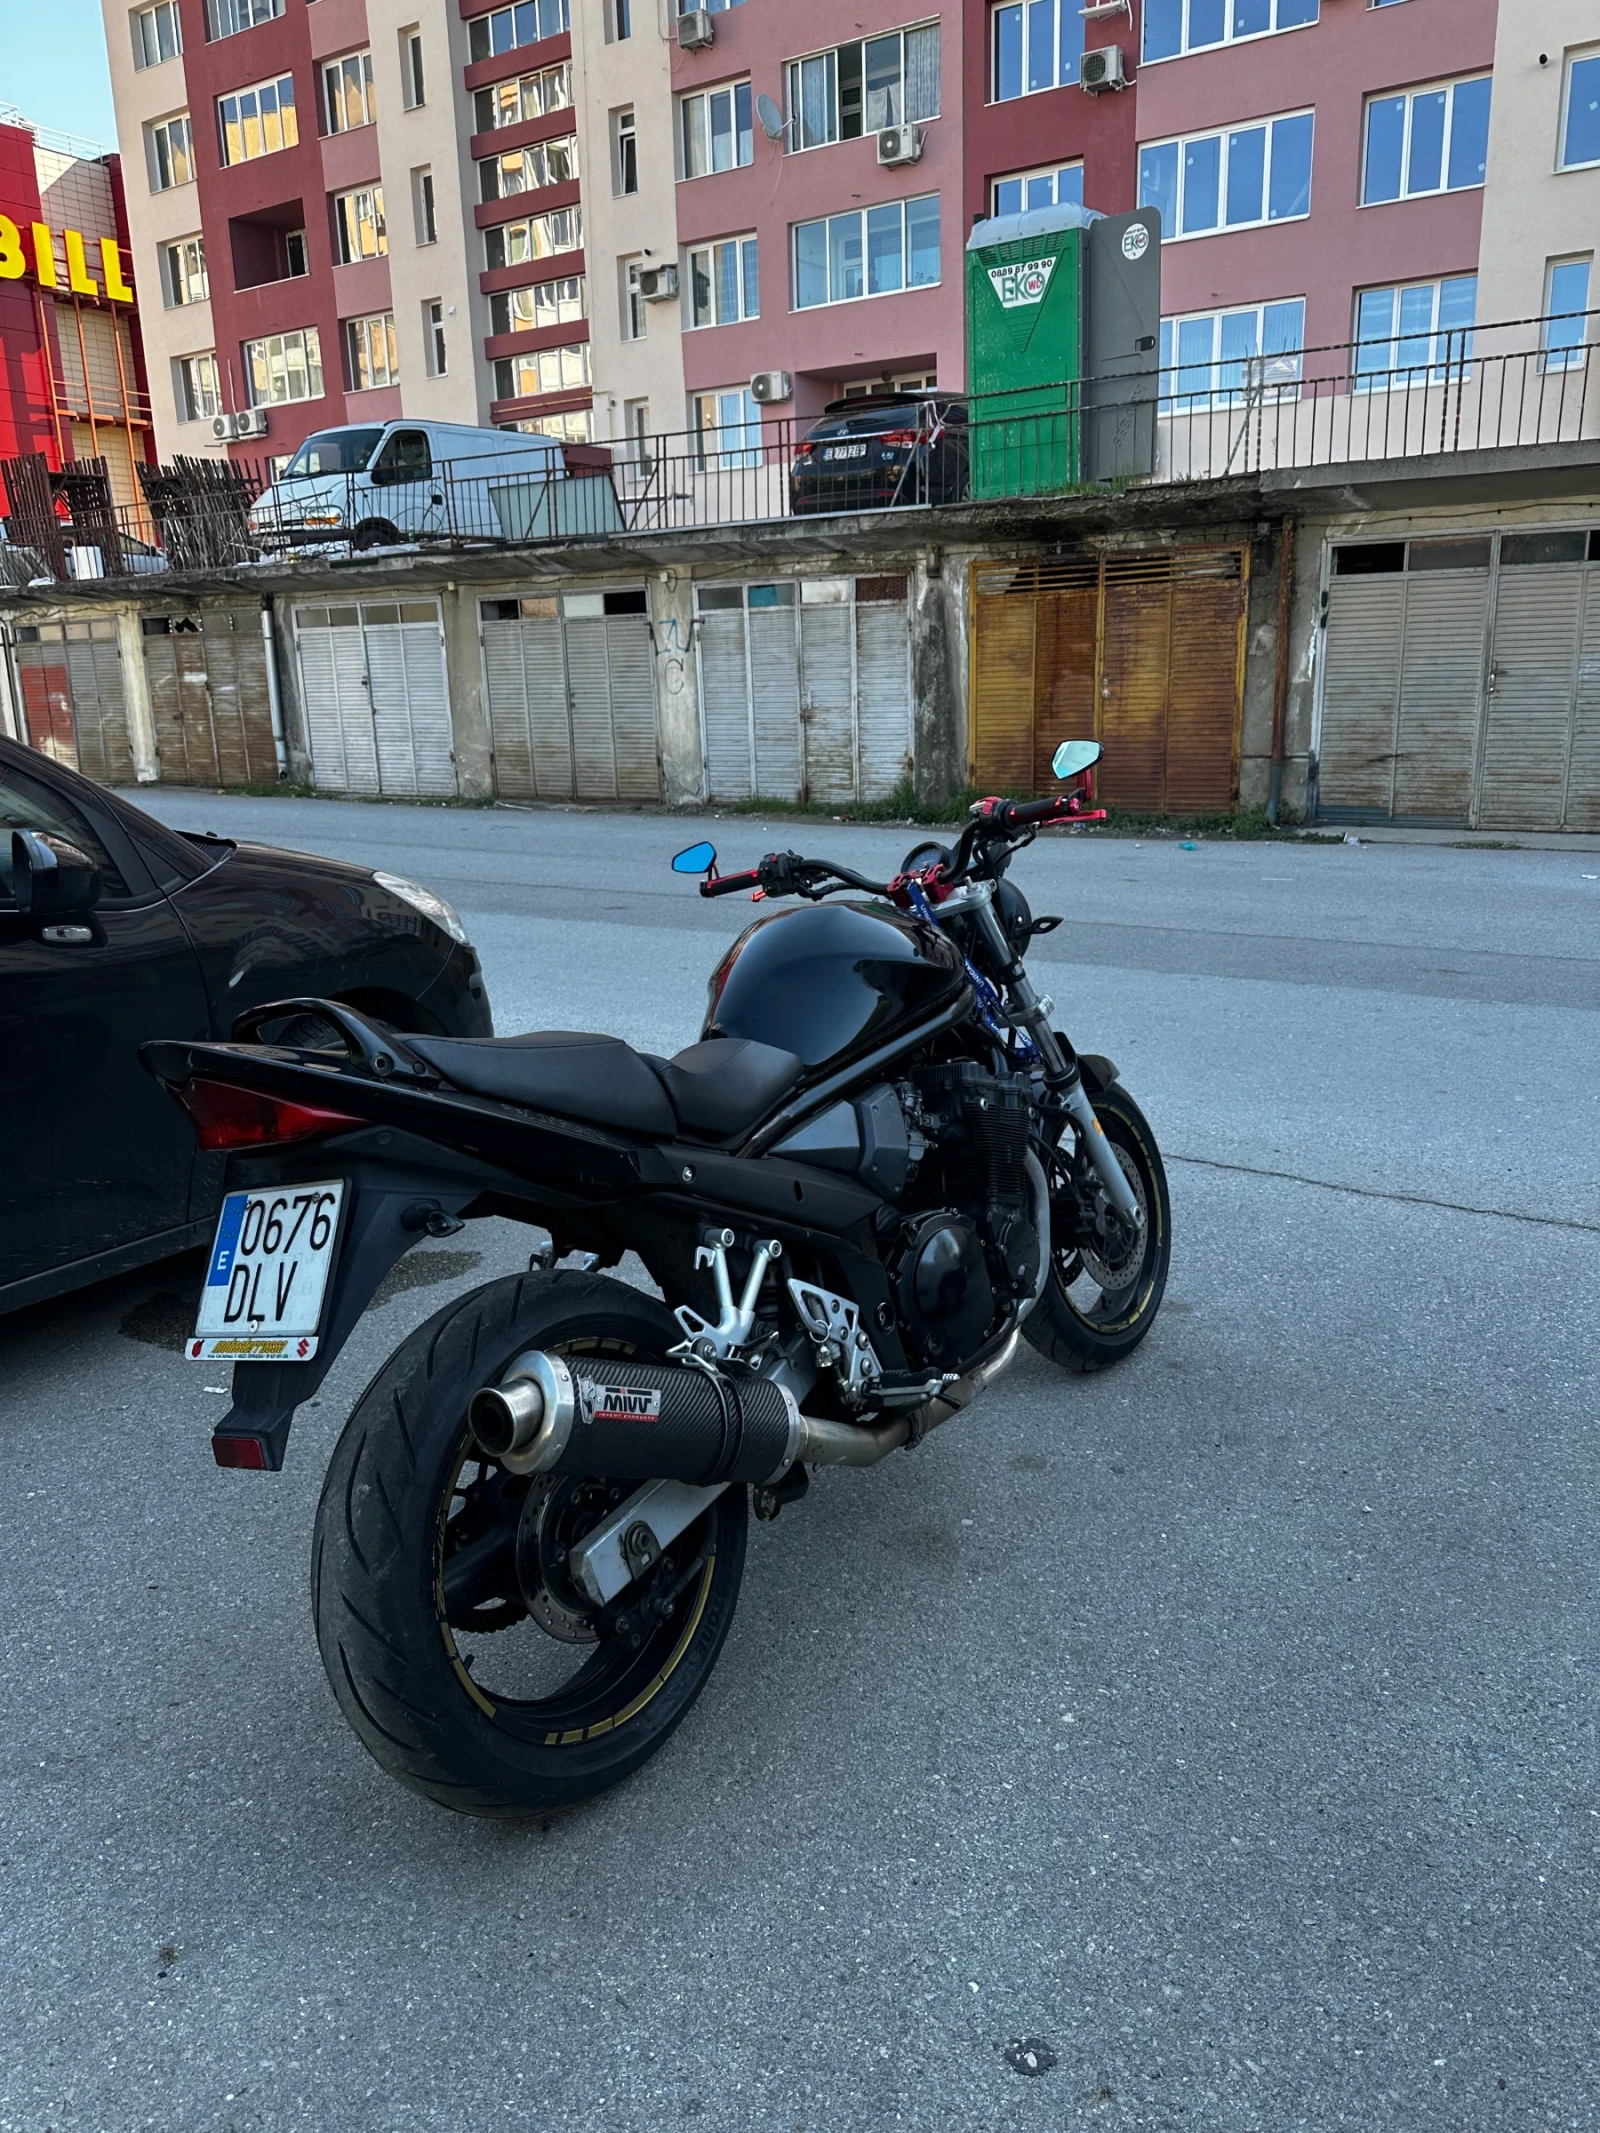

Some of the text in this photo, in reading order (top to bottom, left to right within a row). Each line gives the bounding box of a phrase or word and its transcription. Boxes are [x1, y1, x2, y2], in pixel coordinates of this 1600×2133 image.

[991, 259, 1053, 278] 0889 87 99 90
[1002, 271, 1046, 303] EKO
[240, 1192, 336, 1257] 0676
[217, 1250, 230, 1270] E
[223, 1260, 299, 1323] DLV
